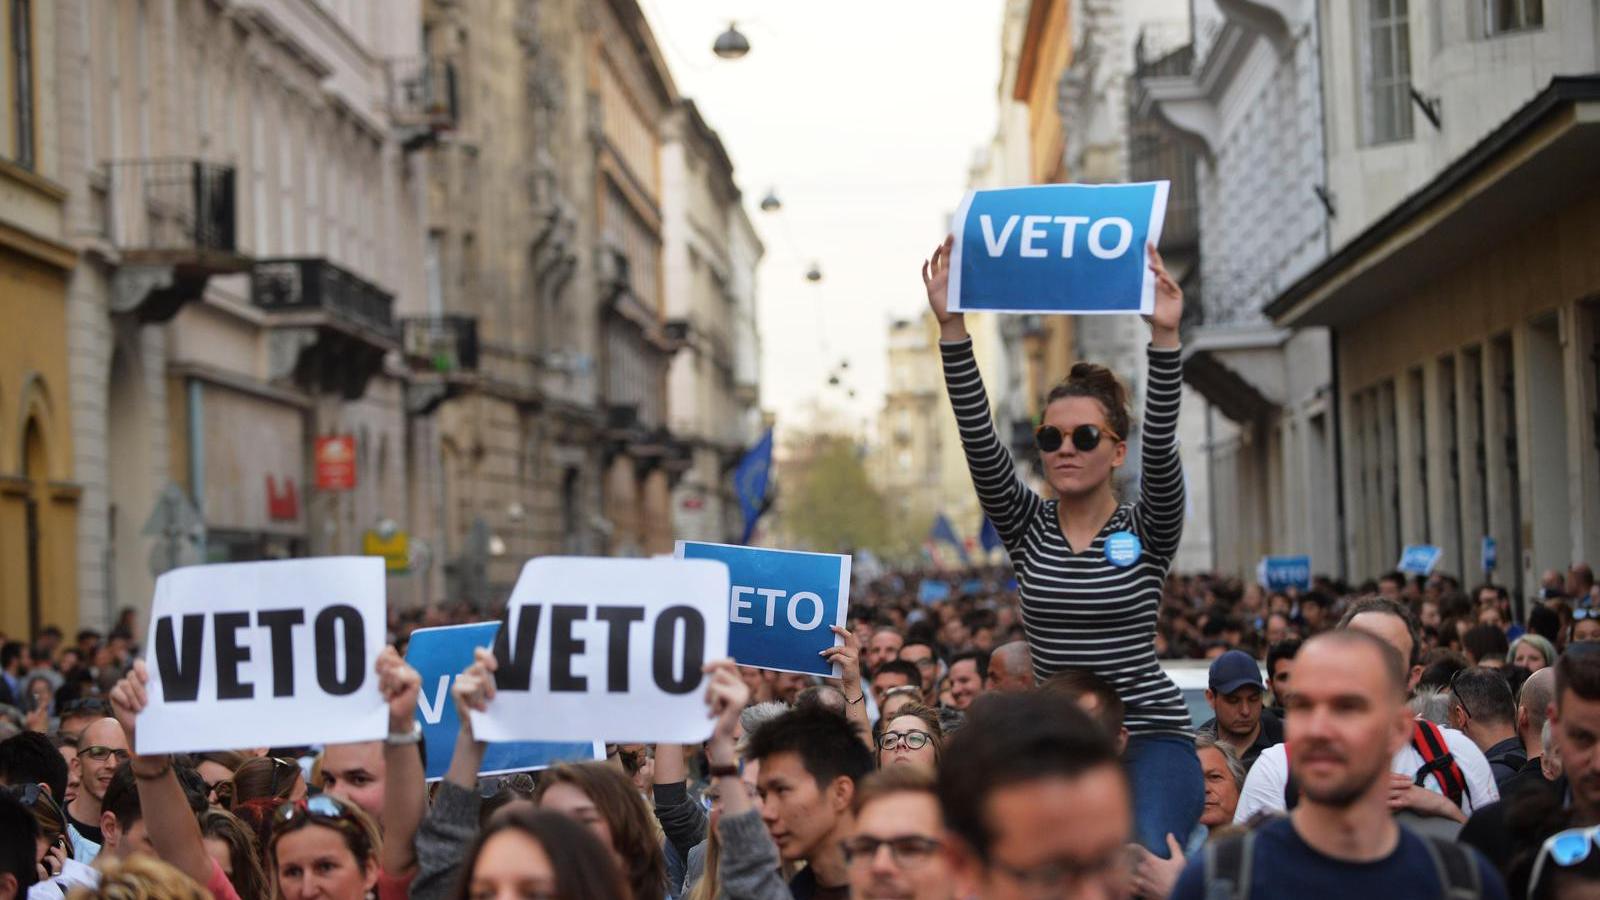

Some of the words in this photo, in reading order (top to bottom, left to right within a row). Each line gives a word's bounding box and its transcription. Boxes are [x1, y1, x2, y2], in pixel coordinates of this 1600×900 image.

[979, 214, 1134, 260] VETO
[729, 584, 825, 631] ETO
[155, 604, 366, 703] VETO
[495, 604, 706, 695] VETO
